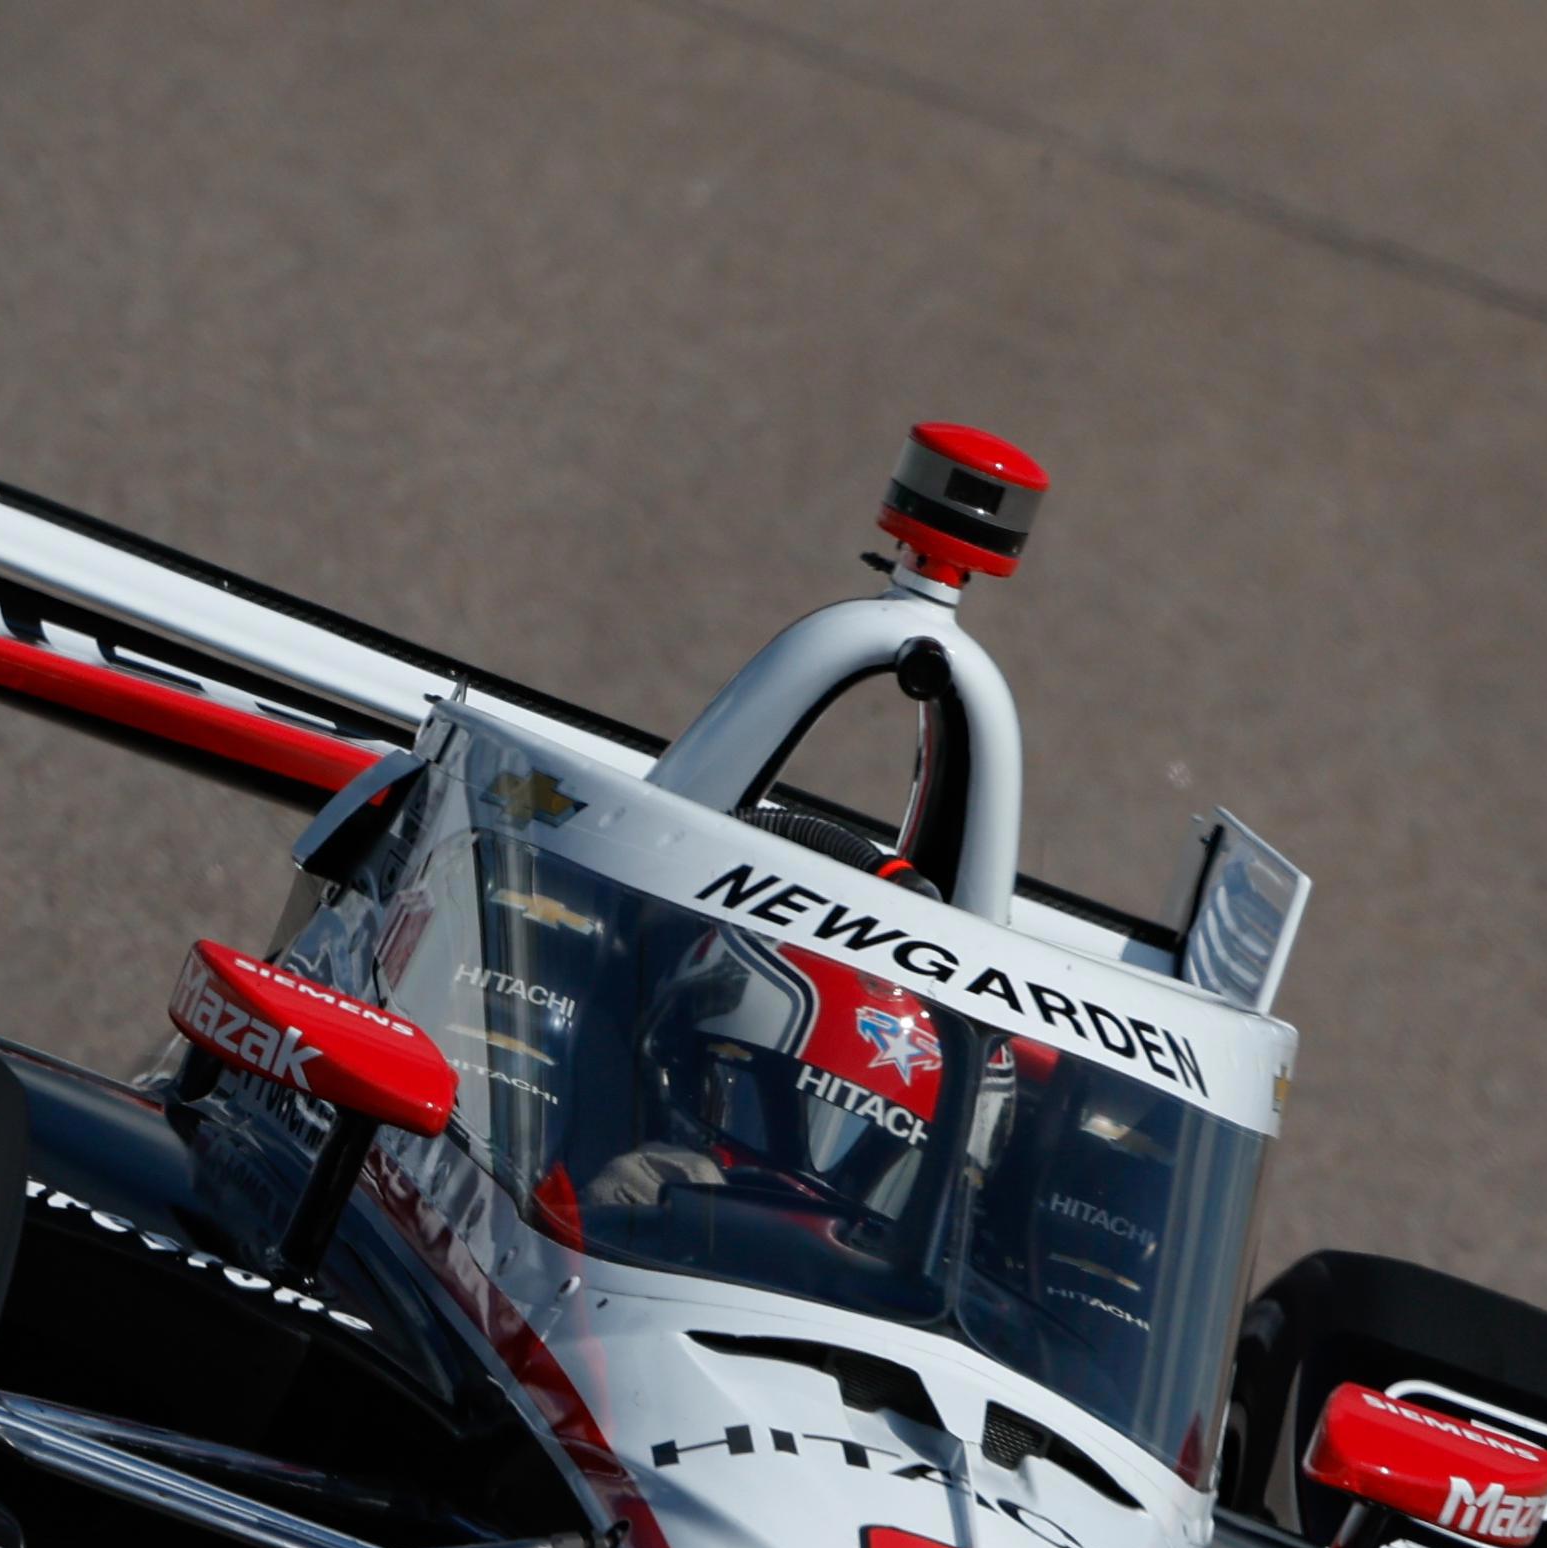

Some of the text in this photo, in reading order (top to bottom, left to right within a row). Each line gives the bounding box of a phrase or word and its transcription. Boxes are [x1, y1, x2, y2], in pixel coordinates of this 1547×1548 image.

[233, 957, 415, 1037] SIEMENS
[454, 963, 576, 1018] HITACHI
[695, 864, 1209, 1099] NEWGARDEN
[168, 957, 323, 1093] Mazak
[796, 1064, 929, 1145] HITACH
[25, 1174, 373, 1332] irestone
[1050, 1192, 1157, 1246] HITACHI
[1046, 1285, 1150, 1332] HITACHI
[1361, 1393, 1540, 1463] SIEMENS
